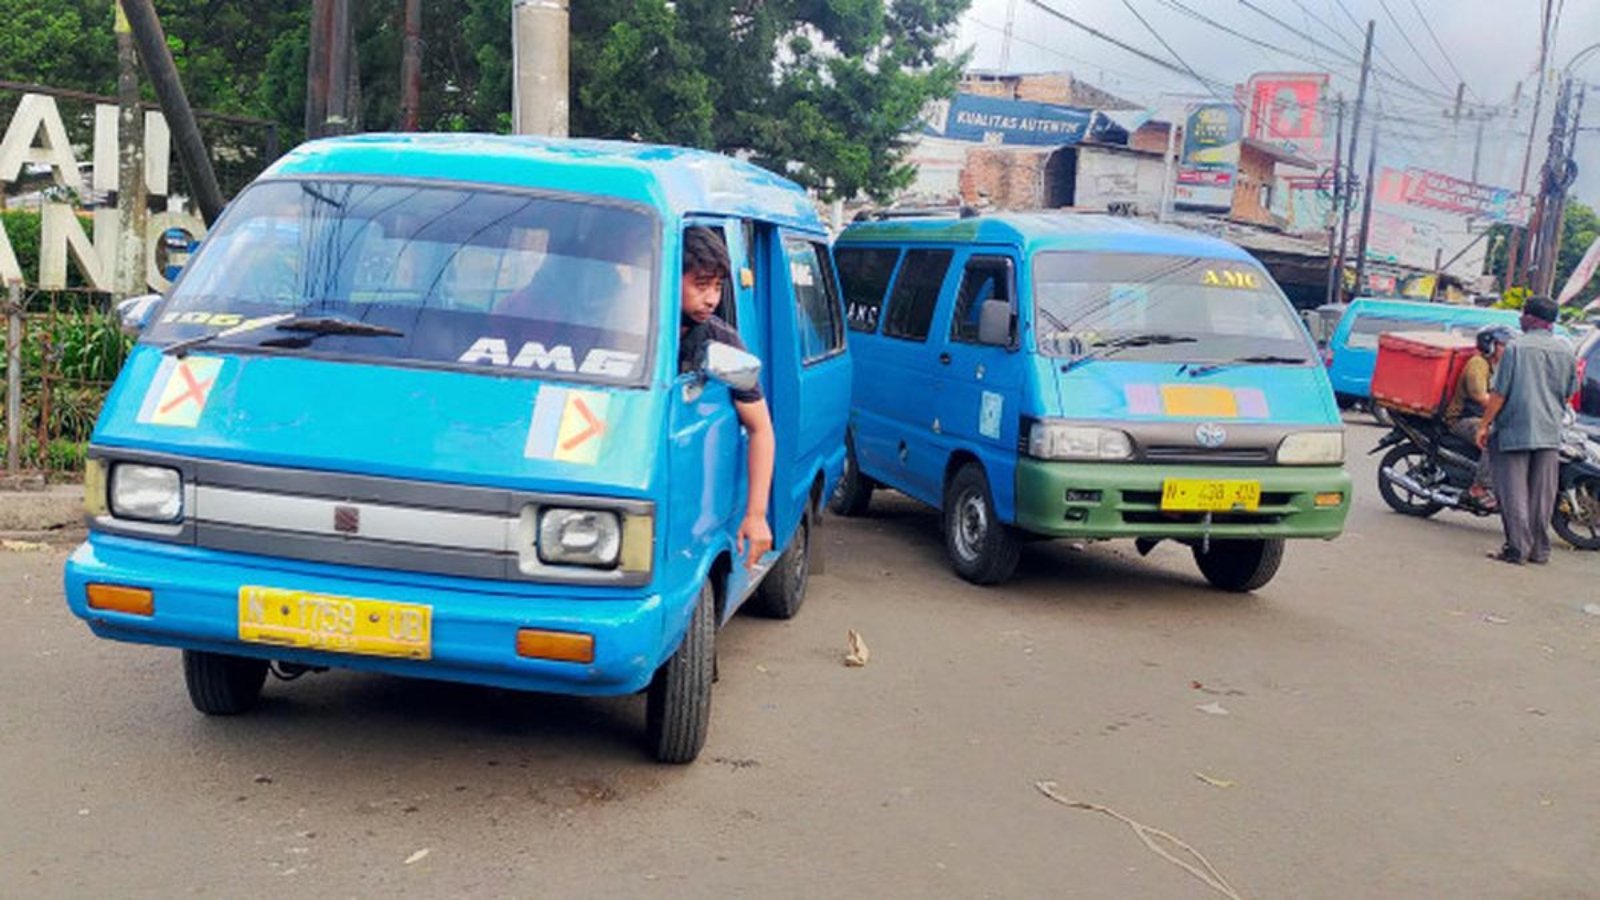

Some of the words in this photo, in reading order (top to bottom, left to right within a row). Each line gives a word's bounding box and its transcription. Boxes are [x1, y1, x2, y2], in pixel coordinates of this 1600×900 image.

[956, 111, 1017, 129] KUALITAS
[457, 337, 642, 378] AMG
[249, 589, 265, 623] N
[299, 597, 355, 635] 1759
